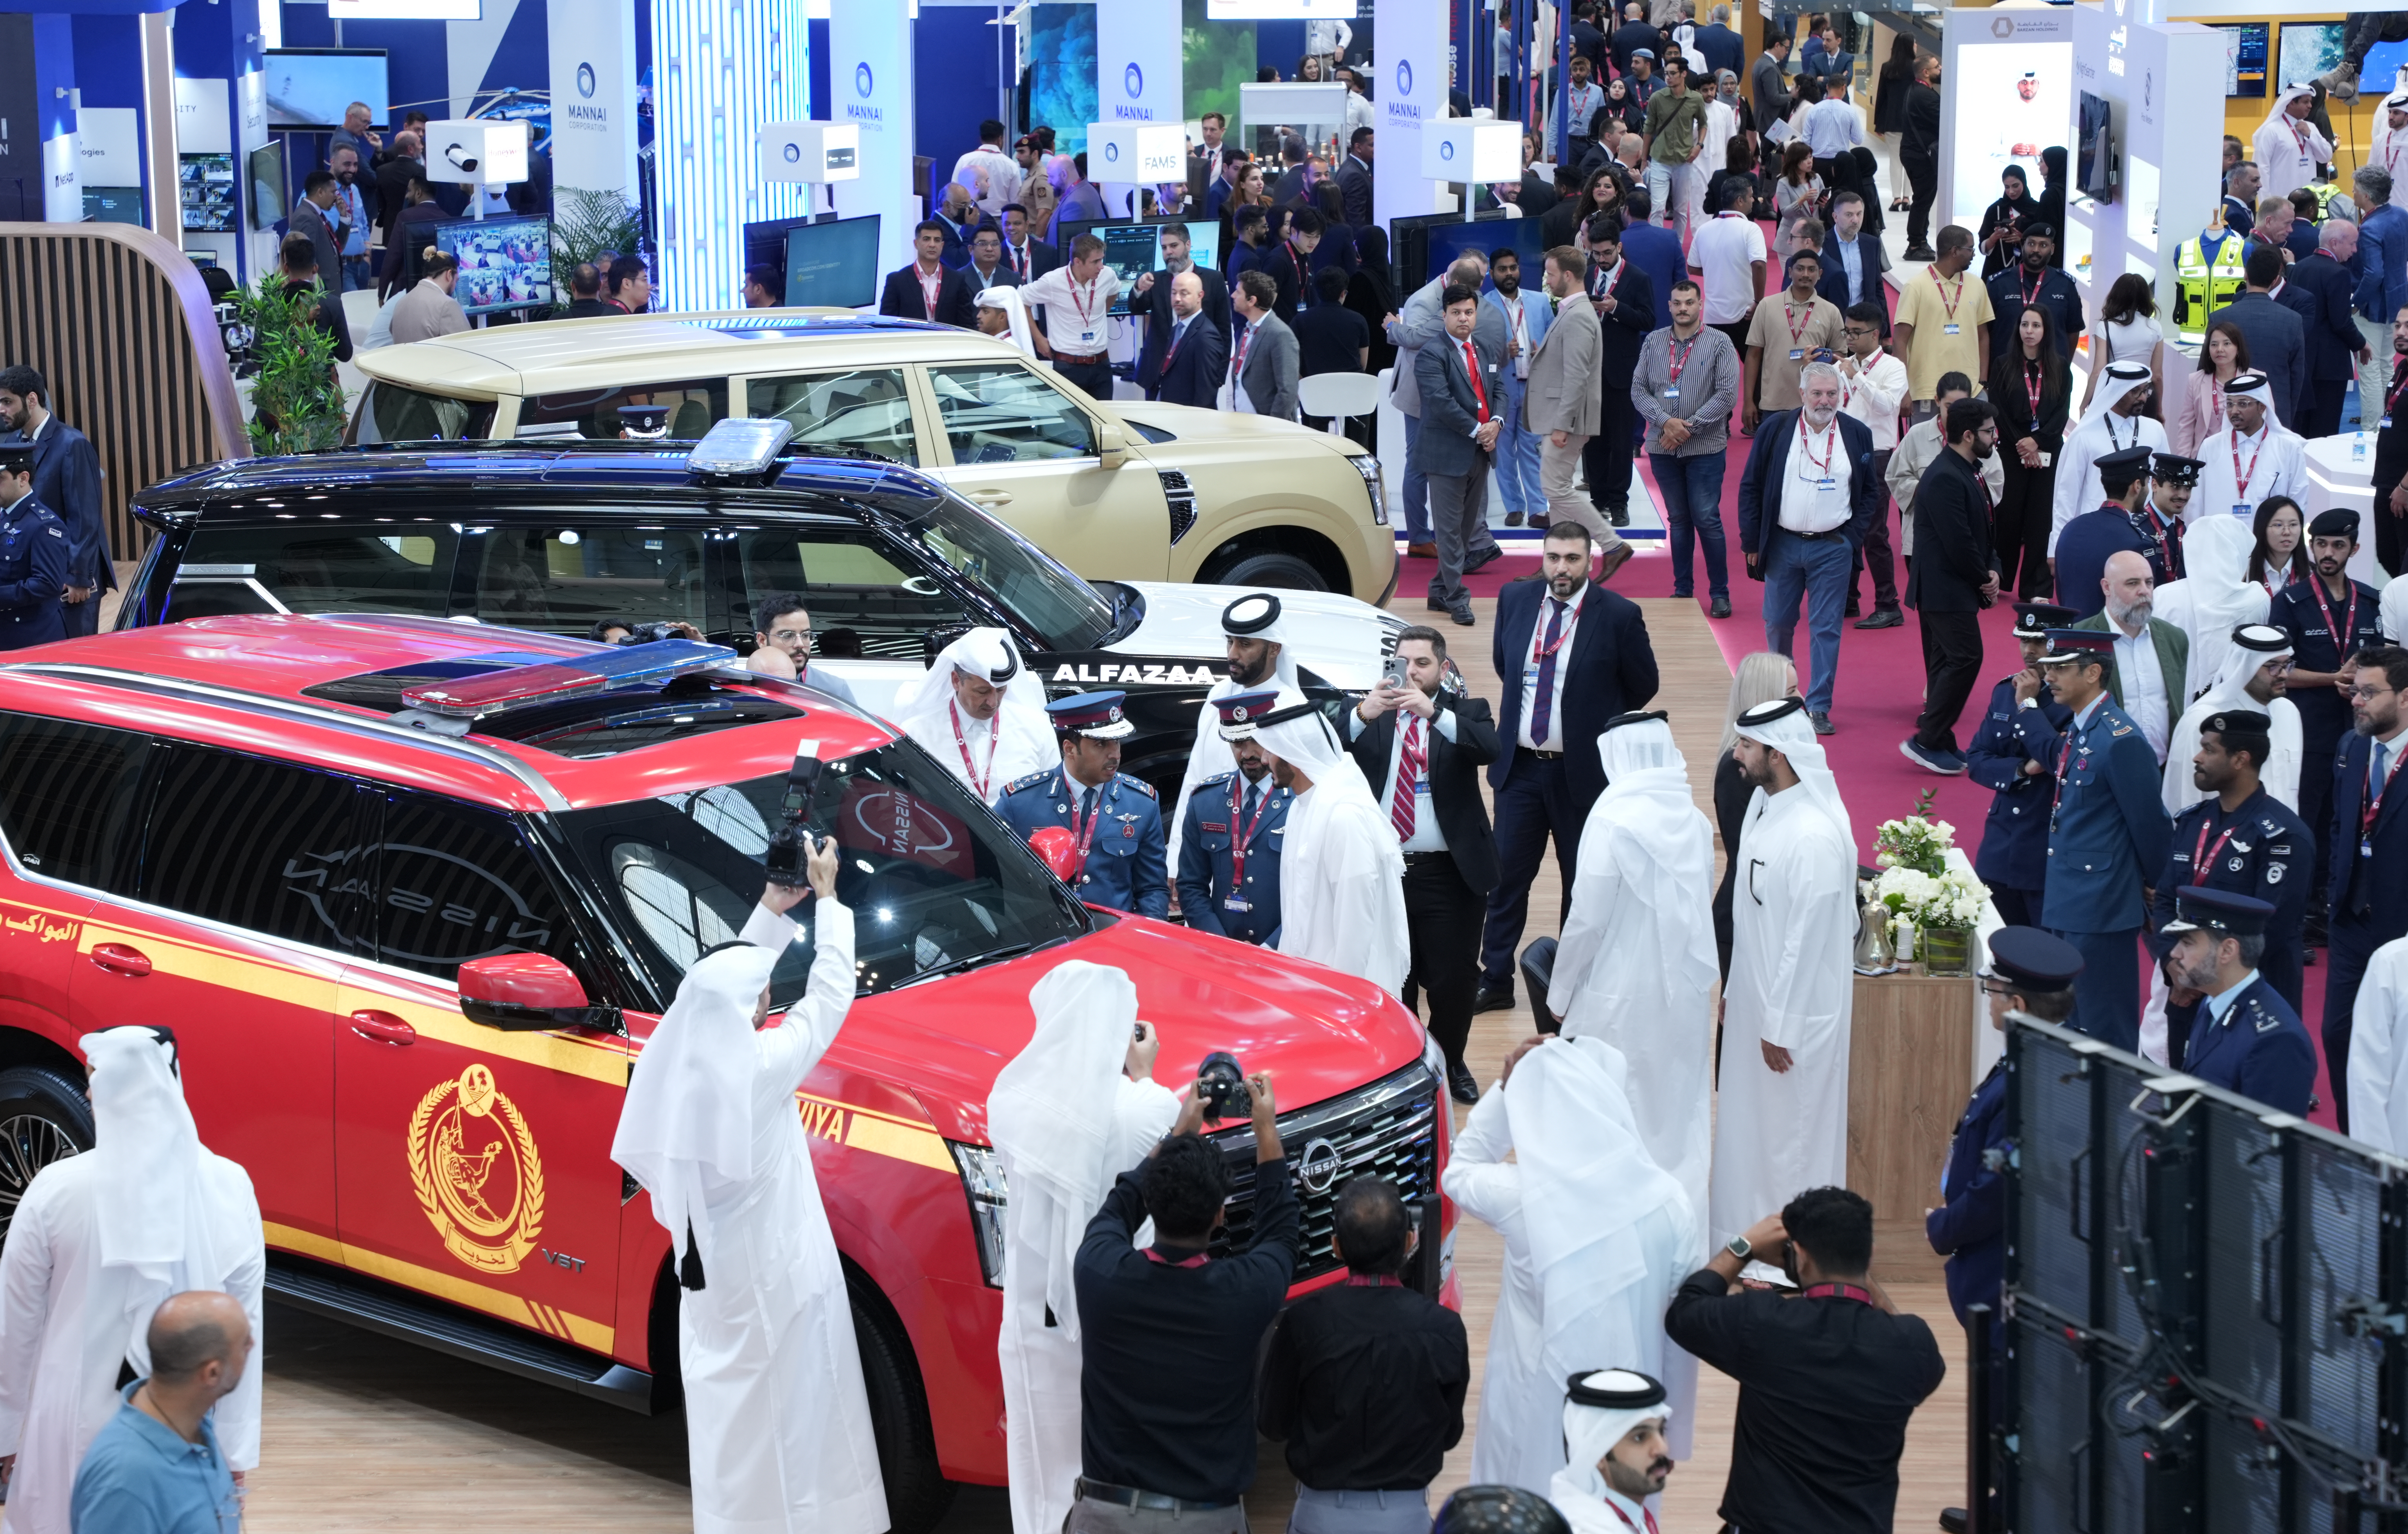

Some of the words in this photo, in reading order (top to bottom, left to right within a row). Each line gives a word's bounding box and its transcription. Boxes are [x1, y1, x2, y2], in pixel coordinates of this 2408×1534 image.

[1449, 0, 1457, 41] Franc
[568, 104, 606, 122] MANNAI
[847, 104, 882, 121] MANNAI
[1116, 104, 1152, 121] MANNAI
[1389, 102, 1420, 119] MANNAI
[247, 113, 261, 129] Security
[569, 121, 607, 132] CORPORATION
[1389, 118, 1421, 130] CORPORATION
[488, 147, 523, 157] Honeywell
[1145, 156, 1176, 170] FAMS
[59, 172, 74, 185] NetApp
[1053, 664, 1216, 683] ALFAZAA
[5, 913, 79, 943] المواكب
[1300, 1156, 1341, 1177] NISSAN
[460, 1240, 506, 1264] لخويا
[542, 1248, 586, 1273] V6T
